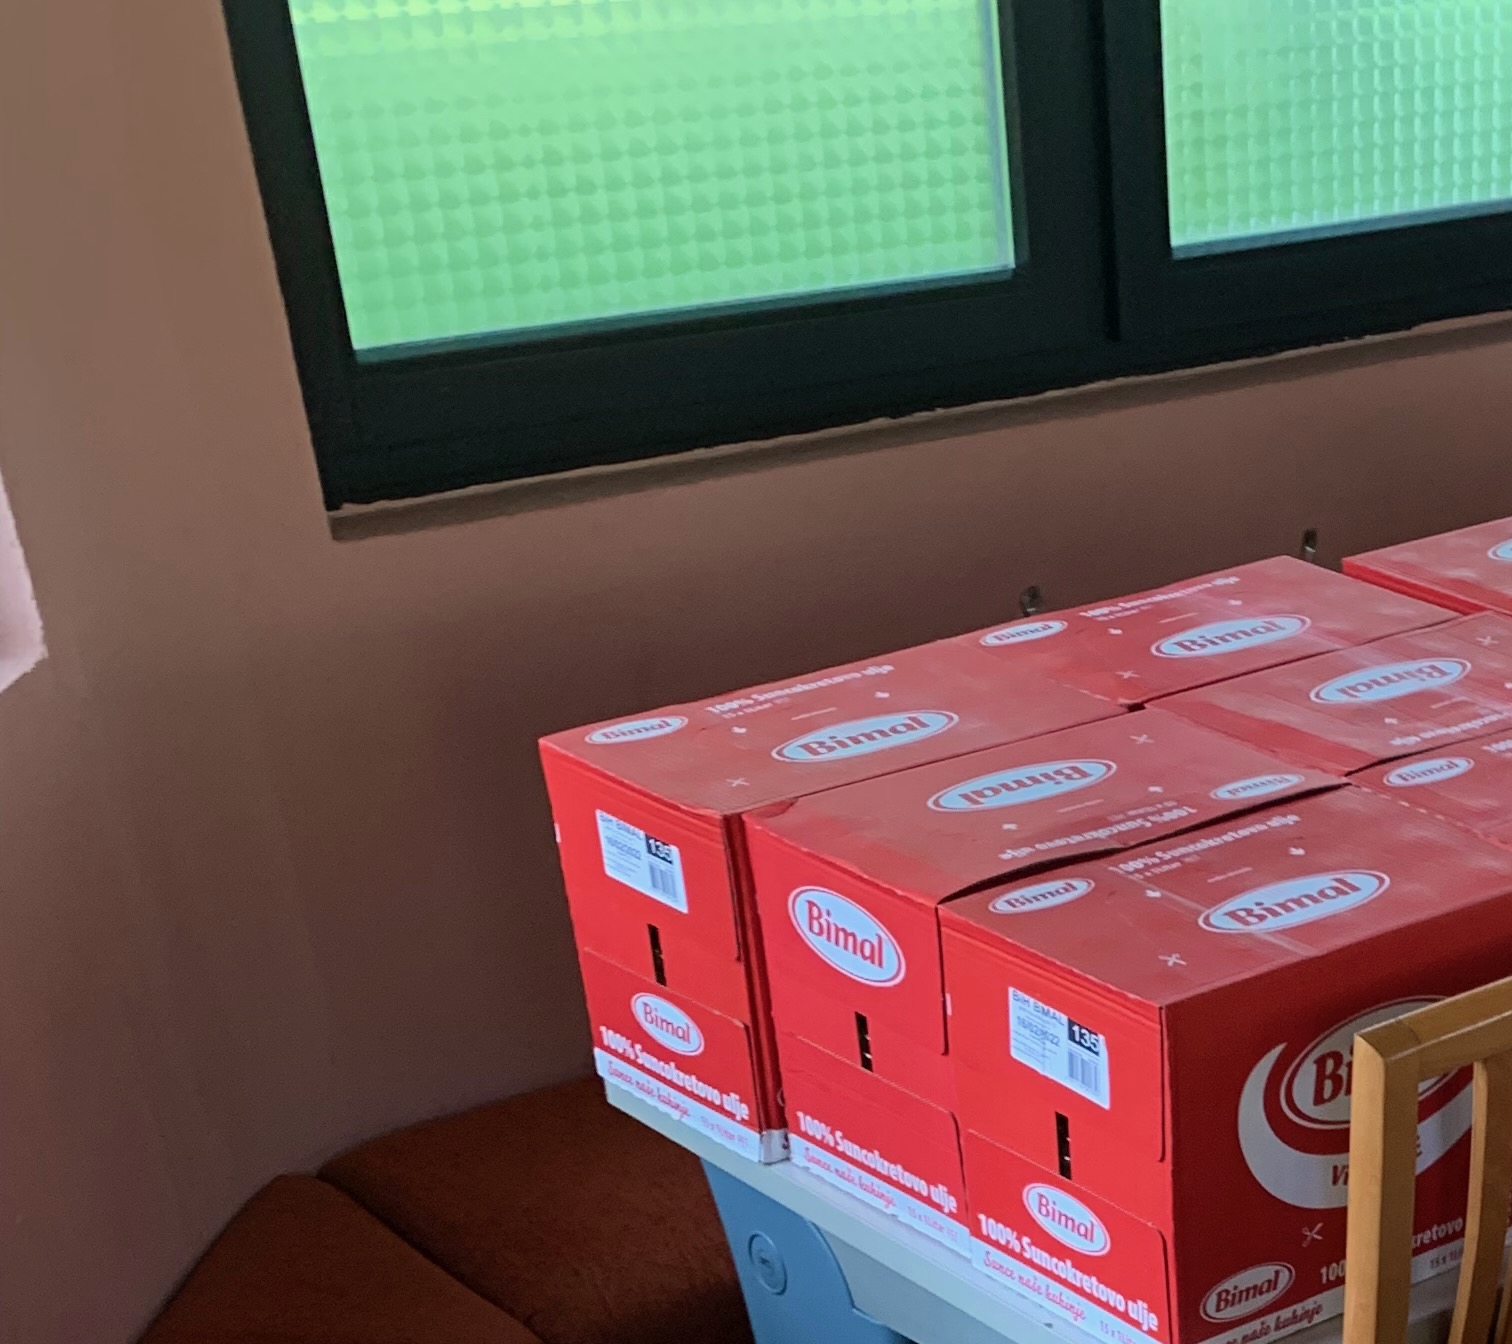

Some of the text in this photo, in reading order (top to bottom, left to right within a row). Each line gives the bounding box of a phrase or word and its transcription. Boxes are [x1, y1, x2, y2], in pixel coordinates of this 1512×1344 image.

[995, 624, 1053, 643] Bimal
[1178, 619, 1284, 653] Bimal
[1340, 663, 1450, 698] Bimal
[602, 719, 673, 742] Bimal
[797, 714, 930, 757] Bimal
[961, 764, 1092, 808] Bimal
[1398, 761, 1457, 783] Bimal
[649, 838, 673, 862] 135
[1004, 882, 1080, 910] Bimal
[1224, 877, 1361, 927] Bimal
[806, 899, 884, 969] Bimal
[643, 1002, 692, 1044] Bimal
[1072, 1026, 1099, 1049] 135
[600, 1026, 749, 1121] 100% Suncokretovo ulje
[797, 1111, 957, 1214] 100% Suncokretovo ulje
[1037, 1193, 1095, 1243] Bimal
[977, 1214, 1021, 1251] 100%
[1022, 1237, 1129, 1310] Suncokretovo
[1127, 1293, 1158, 1331] ulje
[1215, 1272, 1279, 1313] Bimal
[1320, 1262, 1347, 1284] 100
